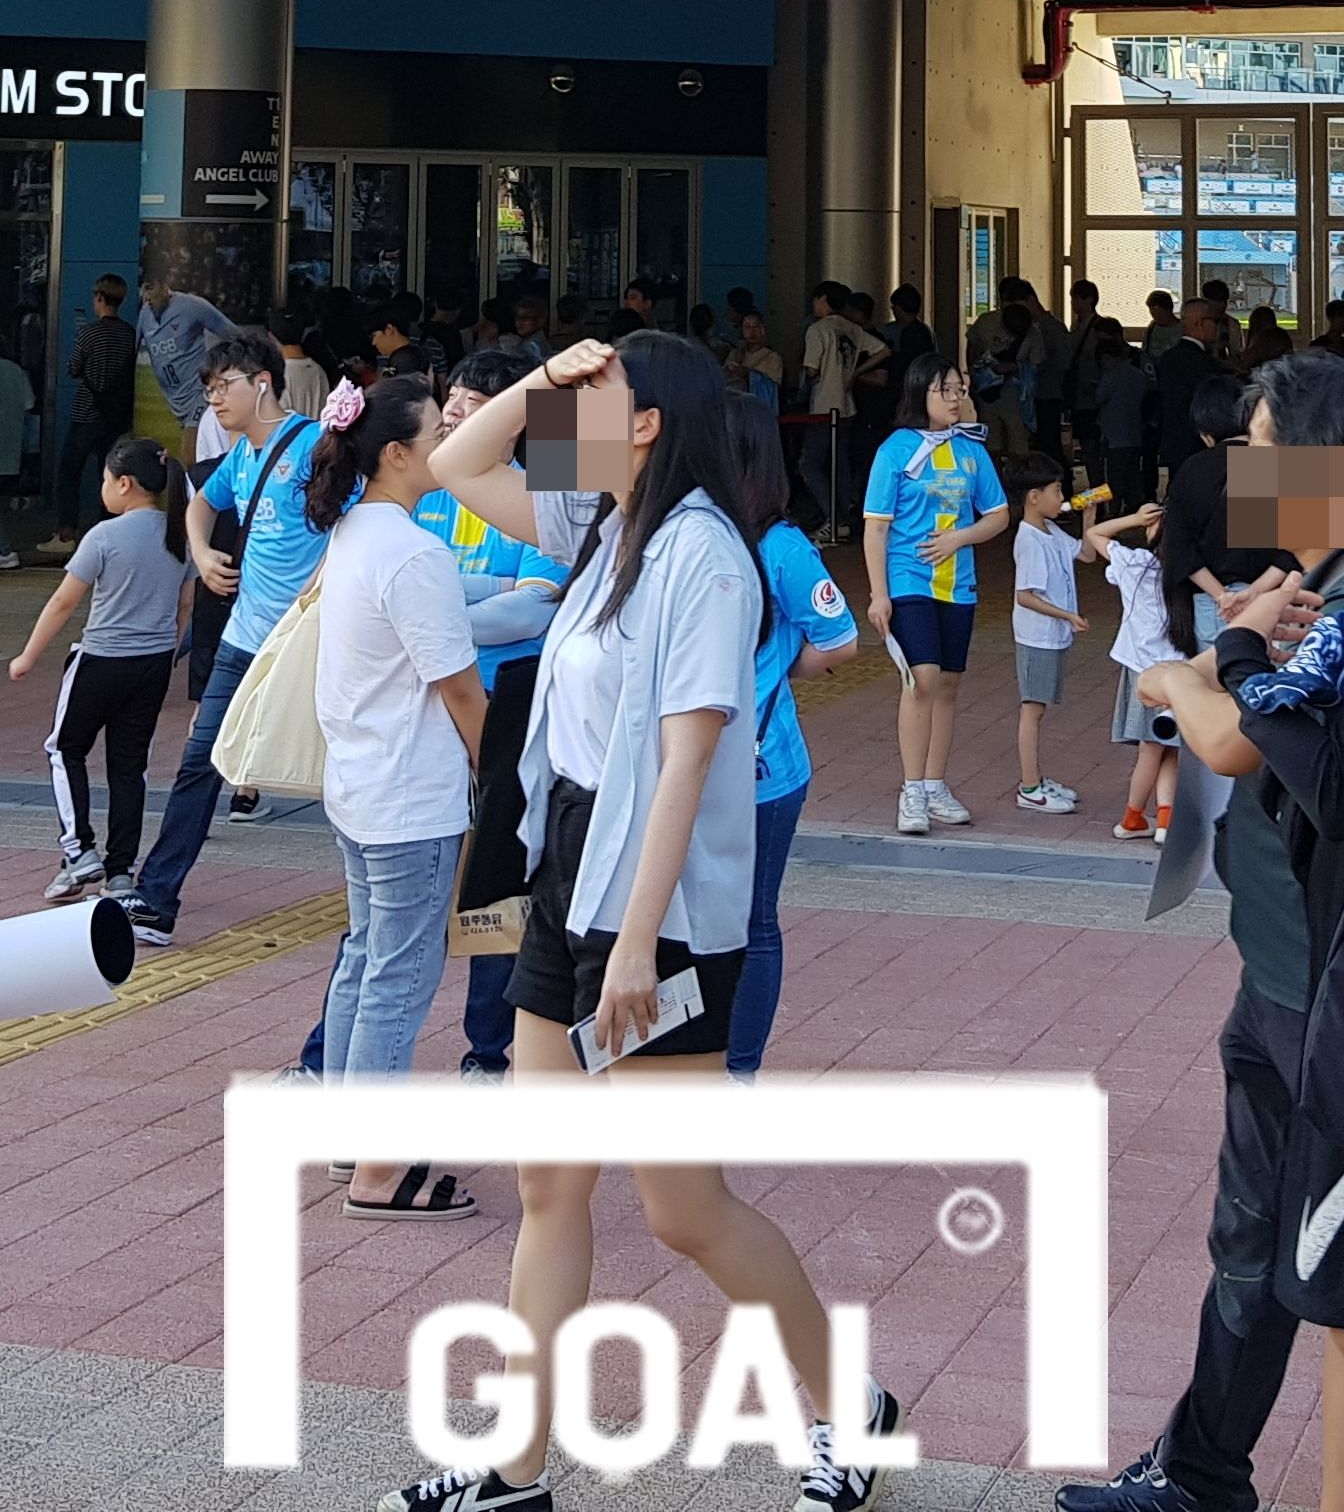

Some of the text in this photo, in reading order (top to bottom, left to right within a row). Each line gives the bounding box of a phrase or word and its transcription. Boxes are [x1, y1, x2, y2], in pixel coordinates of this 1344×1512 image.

[240, 150, 280, 165] AWAY
[193, 167, 279, 183] ANGEL CLUB
